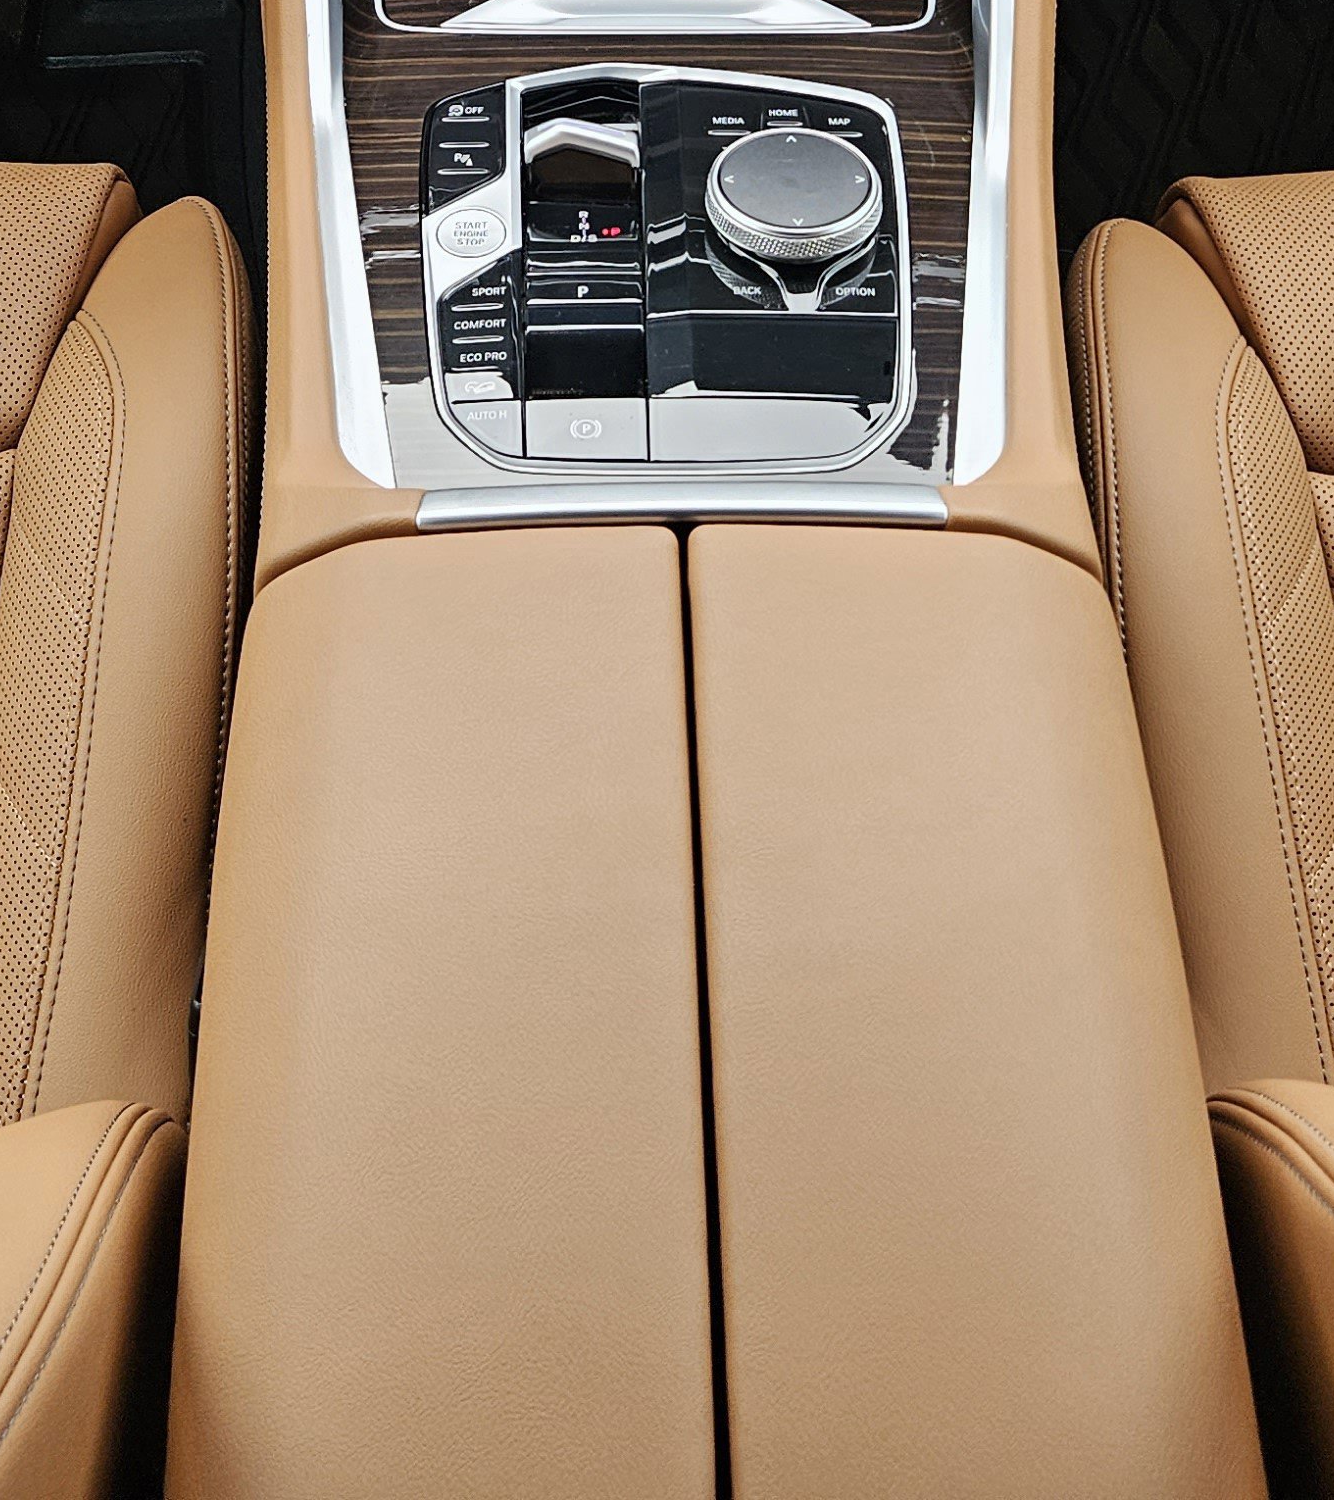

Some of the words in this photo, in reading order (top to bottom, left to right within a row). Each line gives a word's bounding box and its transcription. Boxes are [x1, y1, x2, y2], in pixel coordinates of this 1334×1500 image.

[464, 106, 485, 115] OFF
[768, 108, 799, 118] HOME
[711, 116, 745, 126] MEDIA
[827, 117, 851, 126] MAP
[454, 221, 489, 229] START
[453, 229, 489, 238] ENGINE
[456, 237, 486, 246] STOP
[471, 286, 507, 297] SPORT
[577, 285, 590, 298] P
[733, 285, 763, 296] BACK
[835, 286, 876, 297] OPTION
[453, 318, 507, 331] COMFORT
[459, 352, 483, 363] ECO
[484, 351, 508, 362] PRO
[466, 409, 498, 421] AUTO
[498, 409, 508, 420] H
